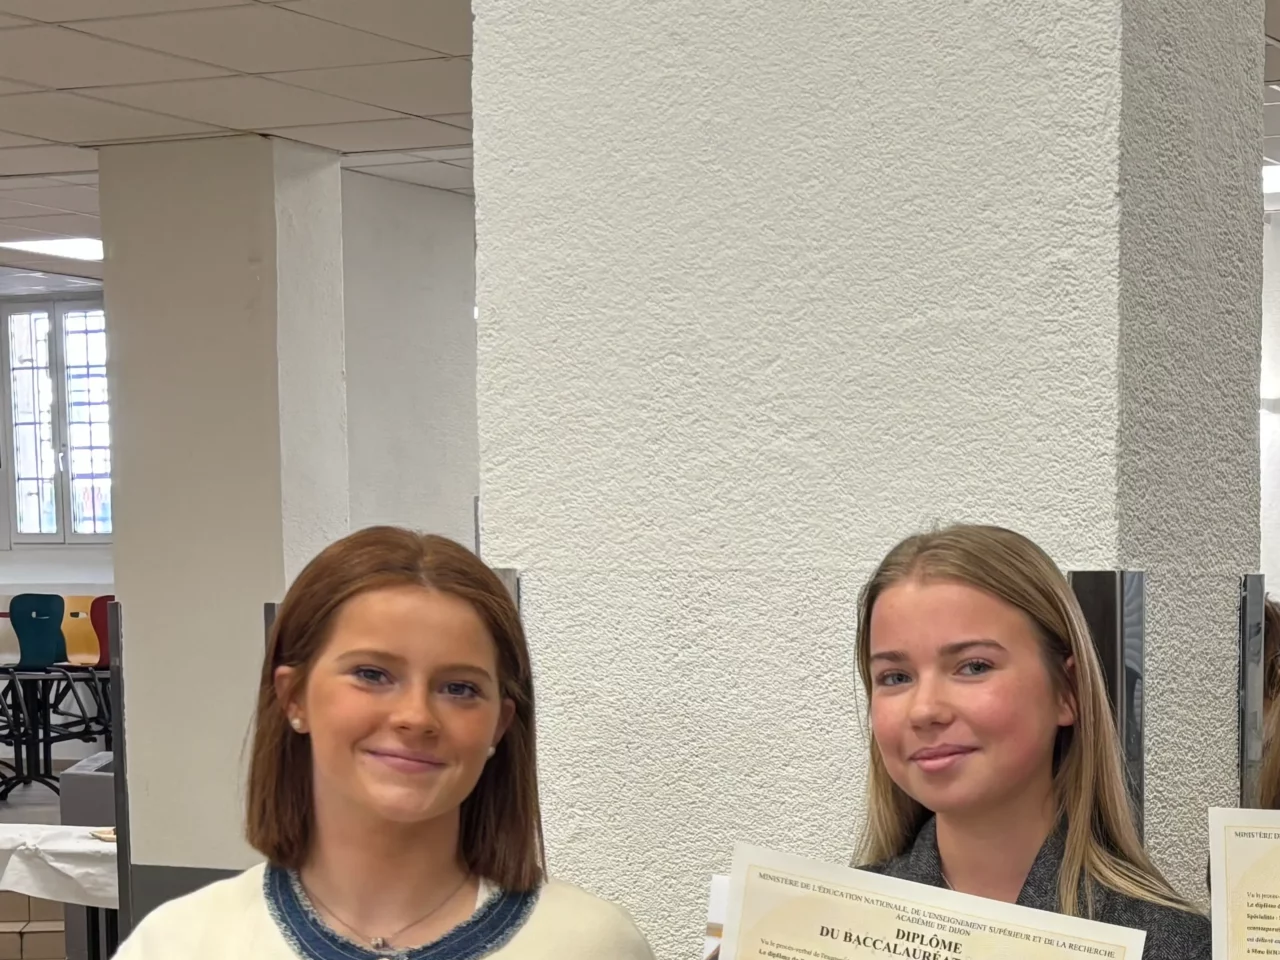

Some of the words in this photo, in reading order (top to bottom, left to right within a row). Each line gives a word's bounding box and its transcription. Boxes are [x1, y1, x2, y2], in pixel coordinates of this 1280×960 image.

[758, 872, 799, 887] MINISTÈRE
[800, 881, 811, 890] DE
[812, 884, 862, 902] L'ÉDUCATION
[911, 908, 921, 916] DE
[922, 910, 987, 931] L'ENSEIGNEMENT
[988, 925, 1031, 941] SUPÉRIEUR
[1032, 935, 1042, 943] ET
[1043, 937, 1055, 946] DE
[1056, 940, 1067, 948] LA
[1068, 942, 1115, 959] RECHERCHE
[895, 913, 935, 928] ACADÉMIE
[936, 923, 947, 931] DE
[948, 925, 971, 936] DIJON
[819, 925, 840, 940] DU
[895, 928, 963, 954] DIPLÔME
